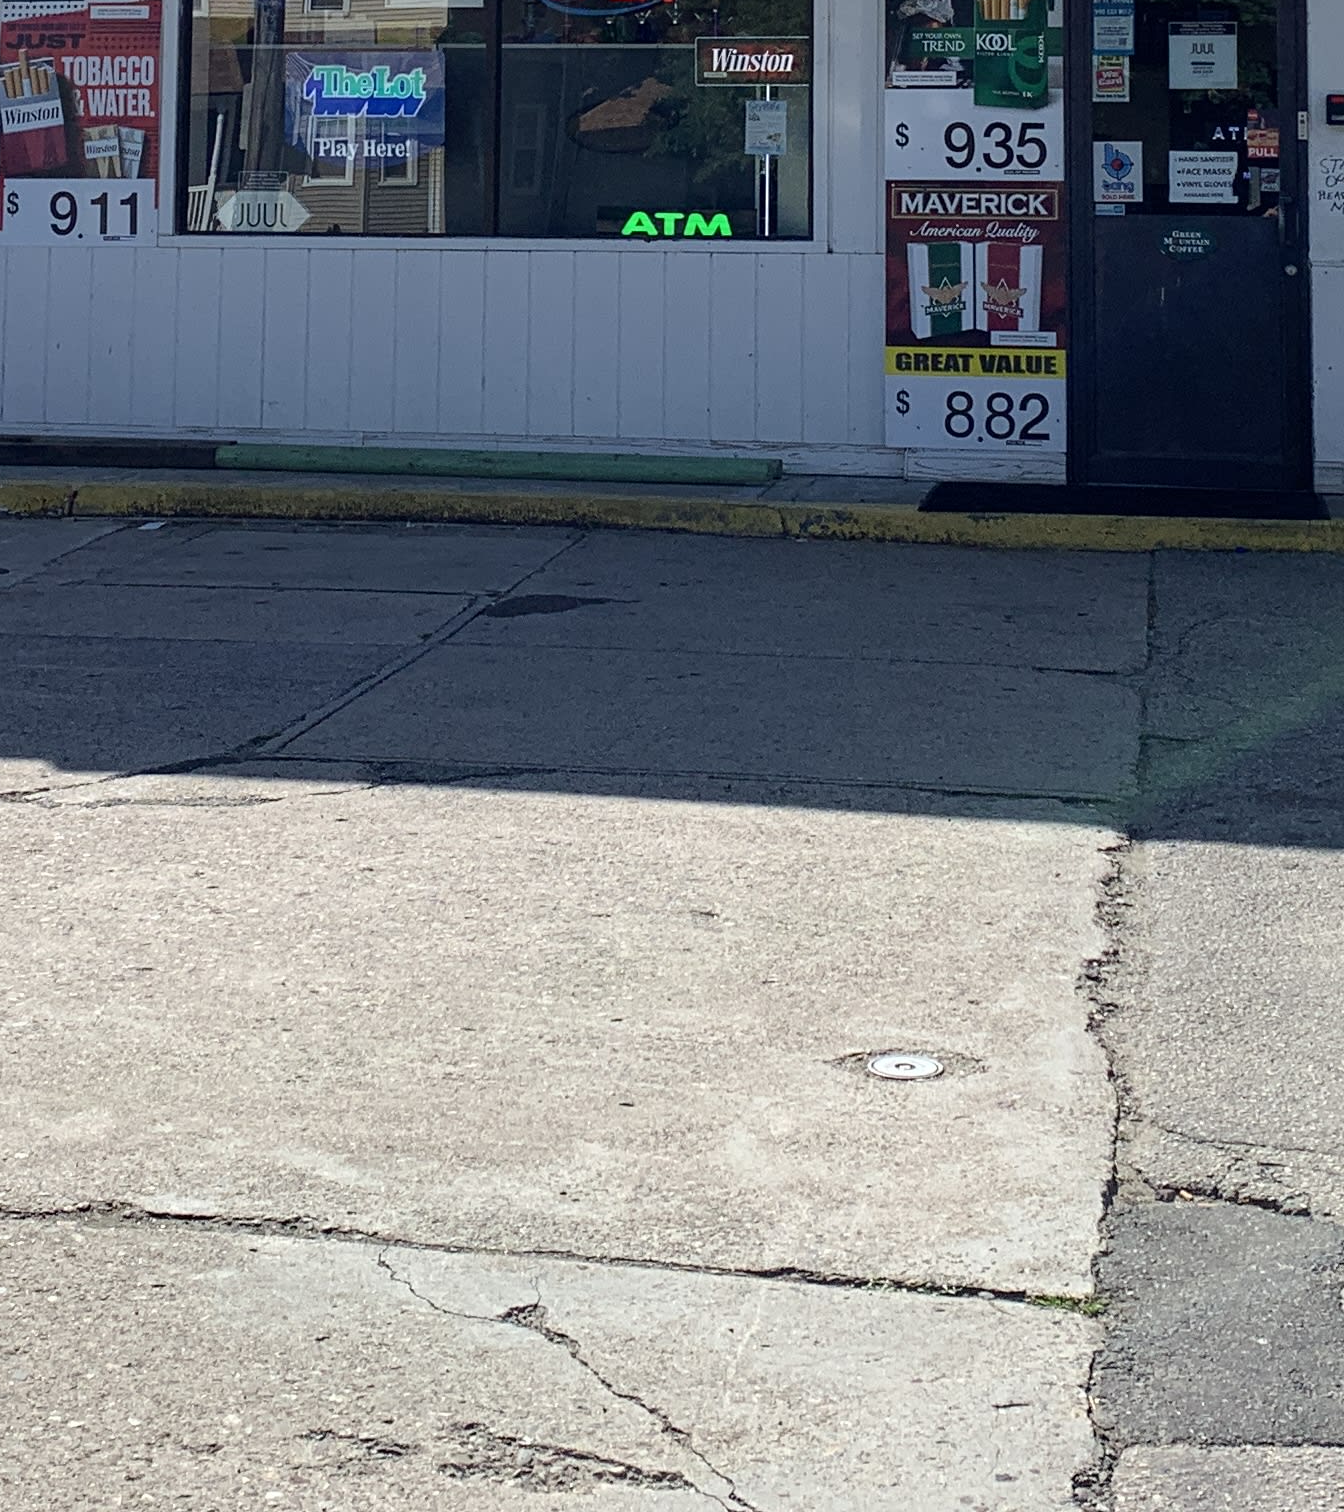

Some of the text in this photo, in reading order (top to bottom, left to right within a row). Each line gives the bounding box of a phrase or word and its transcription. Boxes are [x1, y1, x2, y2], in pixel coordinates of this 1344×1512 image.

[6, 34, 85, 50] JUST
[922, 40, 965, 52] TREND
[925, 32, 943, 40] YOUR
[944, 32, 962, 40] OWN
[976, 33, 1017, 52] KOOL
[61, 55, 155, 86] TOBACCO
[711, 48, 793, 73] Winston
[72, 88, 155, 117] & WATER.
[4, 106, 59, 126] Winston
[1211, 126, 1248, 140] AT
[318, 138, 411, 162] Play Here!
[896, 122, 1047, 172] $ 9.35
[1248, 147, 1278, 158] PULL
[1181, 168, 1232, 176] FACE MASKS
[1181, 180, 1234, 188] VINYL GLOVES
[7, 190, 138, 239] $ 9.11
[236, 202, 287, 228] JUUL
[900, 192, 1049, 216] MAVERICK
[621, 211, 732, 237] ATM
[909, 220, 1040, 243] American Quality
[895, 352, 1058, 374] GREAT VALUE
[896, 390, 1051, 443] $ 8.82
